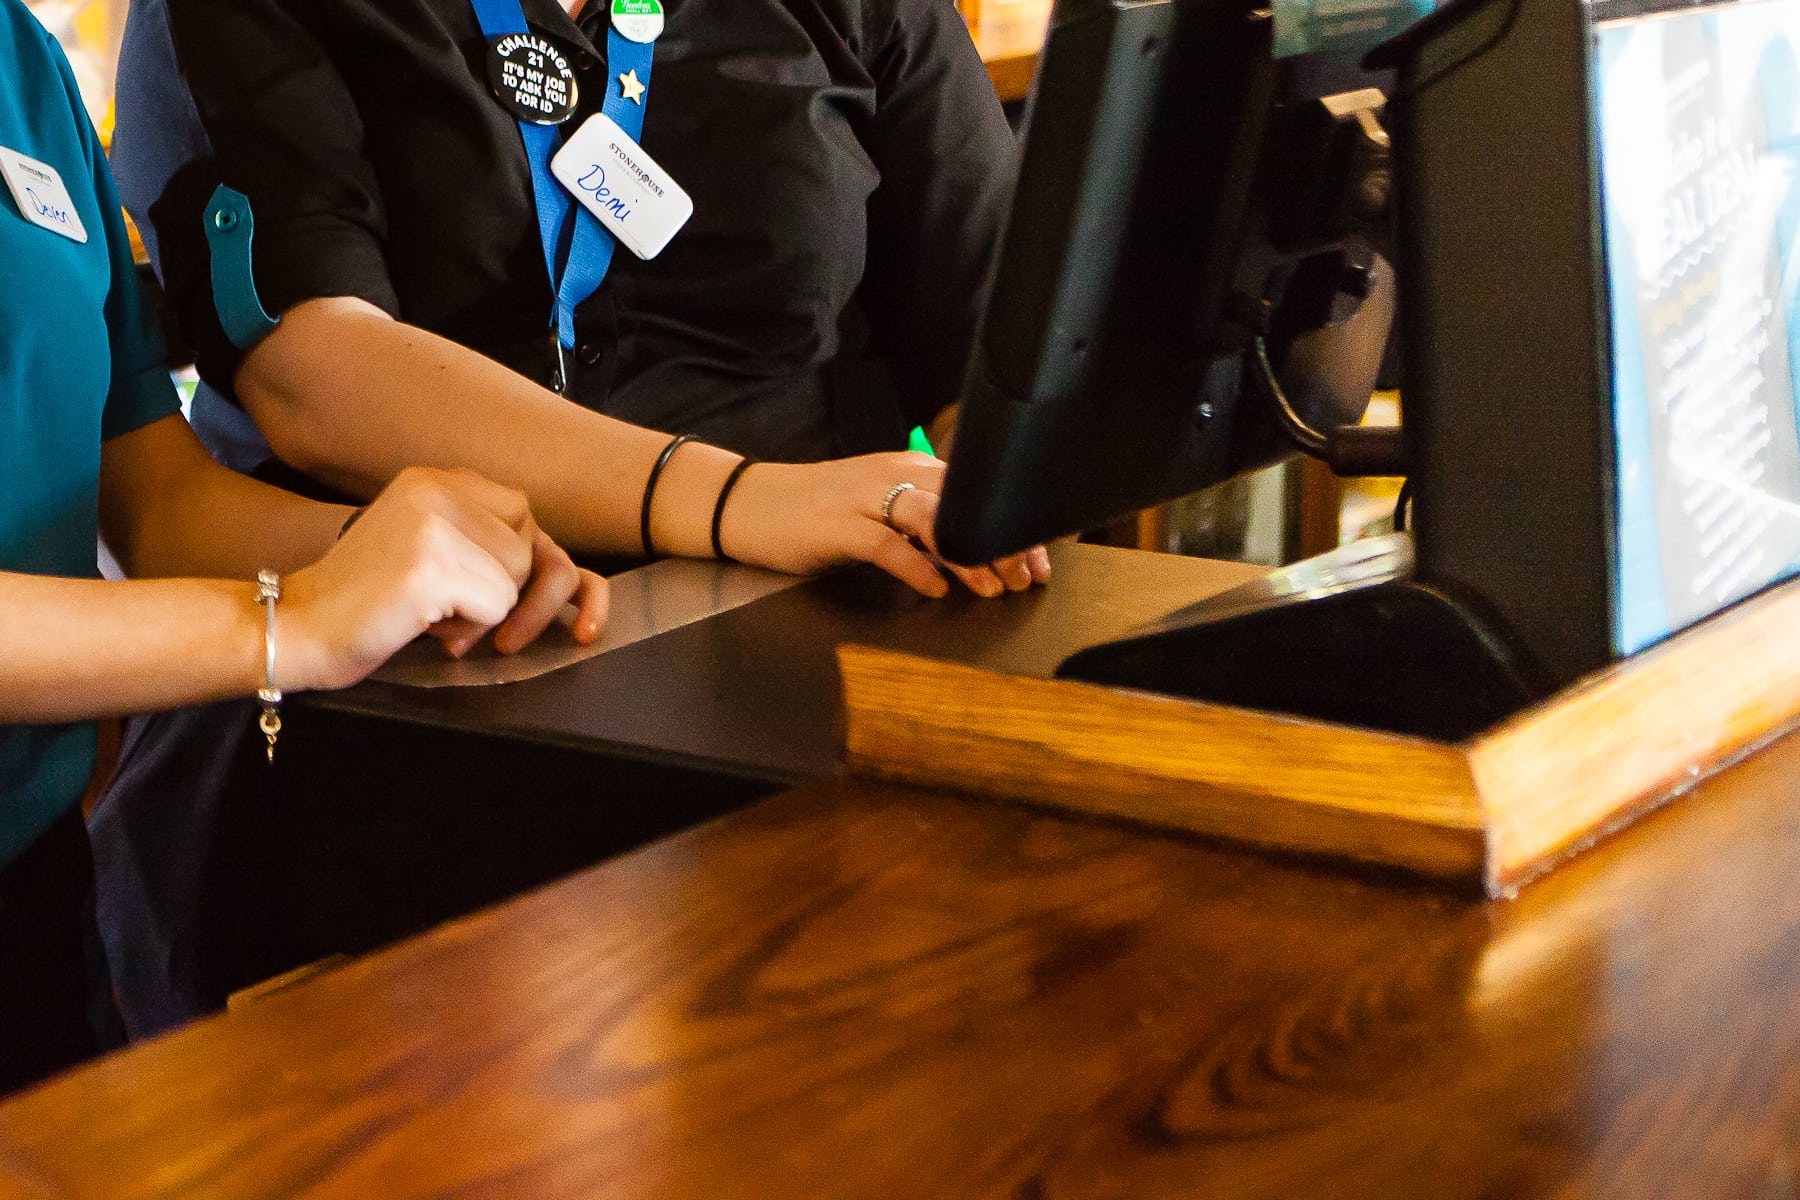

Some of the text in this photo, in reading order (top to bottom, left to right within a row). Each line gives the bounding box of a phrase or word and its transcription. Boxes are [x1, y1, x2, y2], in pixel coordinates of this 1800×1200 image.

[496, 34, 572, 79] CHALLENGE
[527, 51, 544, 69] 21
[502, 73, 567, 106] TO ASK YOU
[503, 60, 566, 93] IT'S MY JOB
[515, 90, 554, 114] FOR ID
[577, 164, 639, 223] Demi
